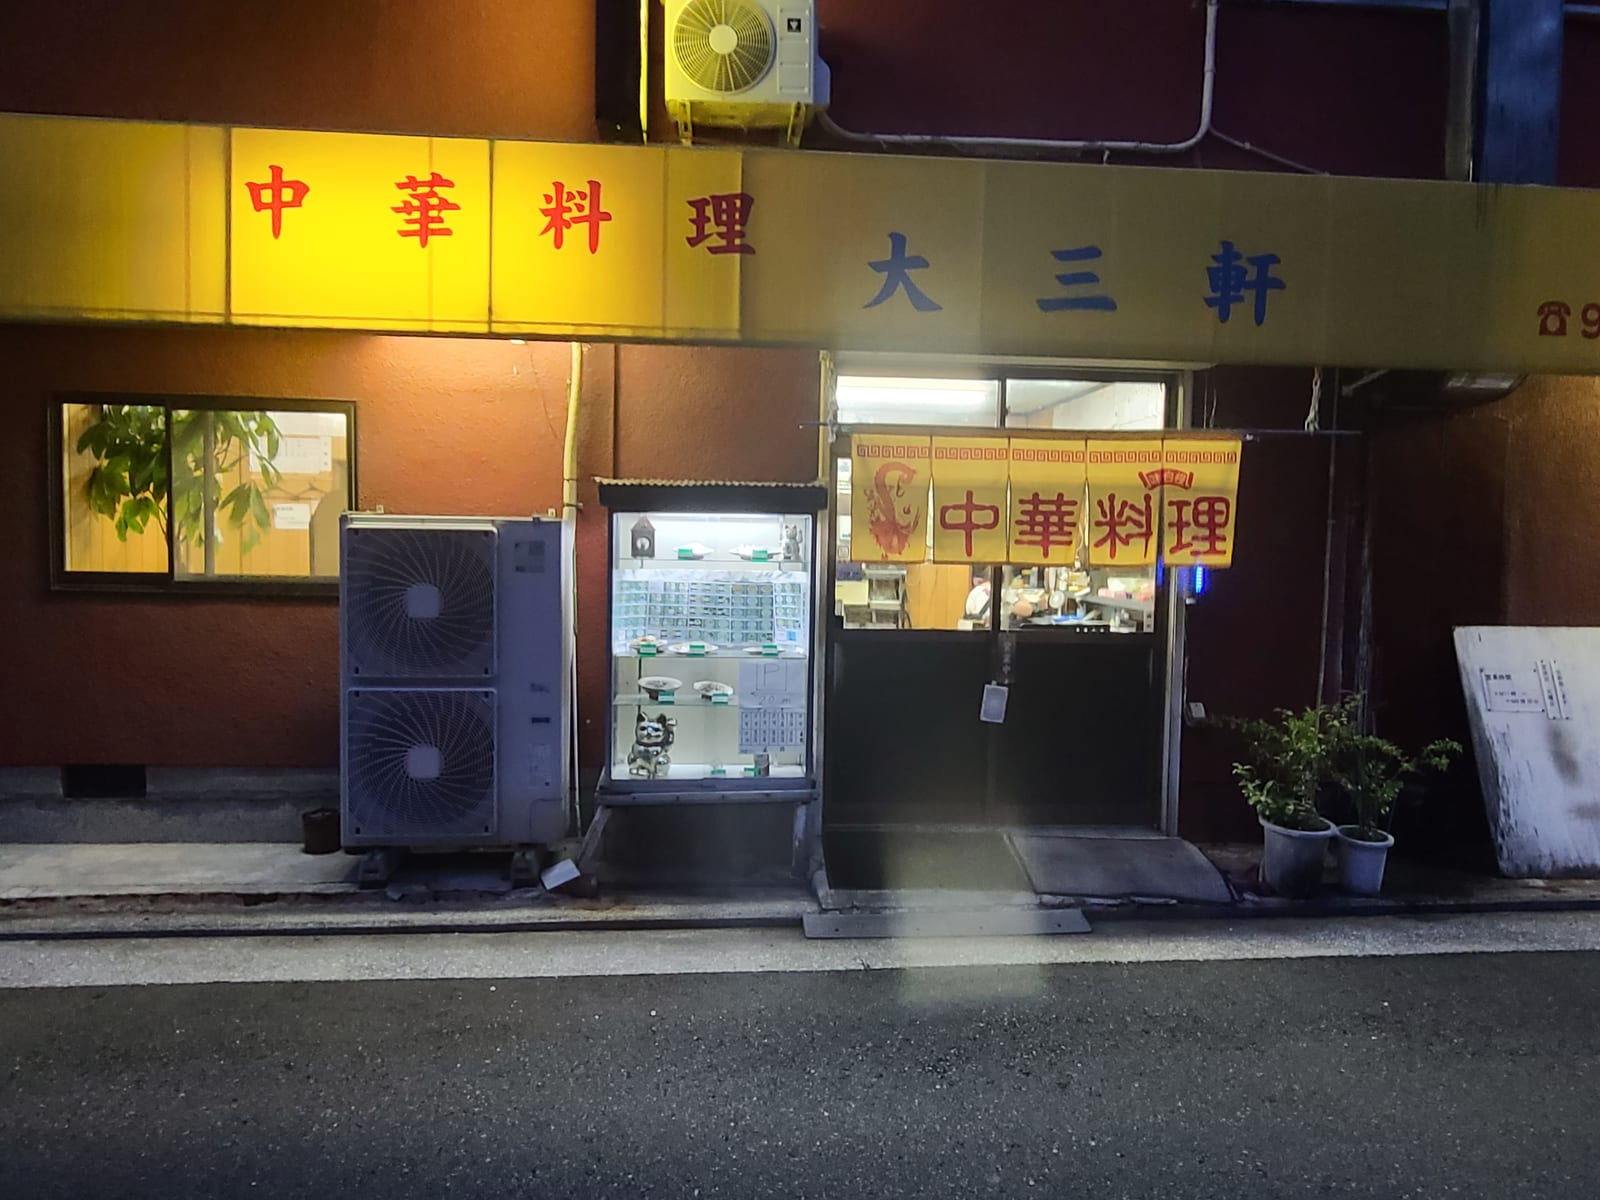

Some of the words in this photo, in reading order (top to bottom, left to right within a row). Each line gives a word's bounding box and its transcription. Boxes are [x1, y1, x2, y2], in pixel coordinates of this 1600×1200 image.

[245, 163, 757, 256] 中華料理
[862, 231, 1287, 326] 大三軒
[939, 490, 1231, 561] 中華料理
